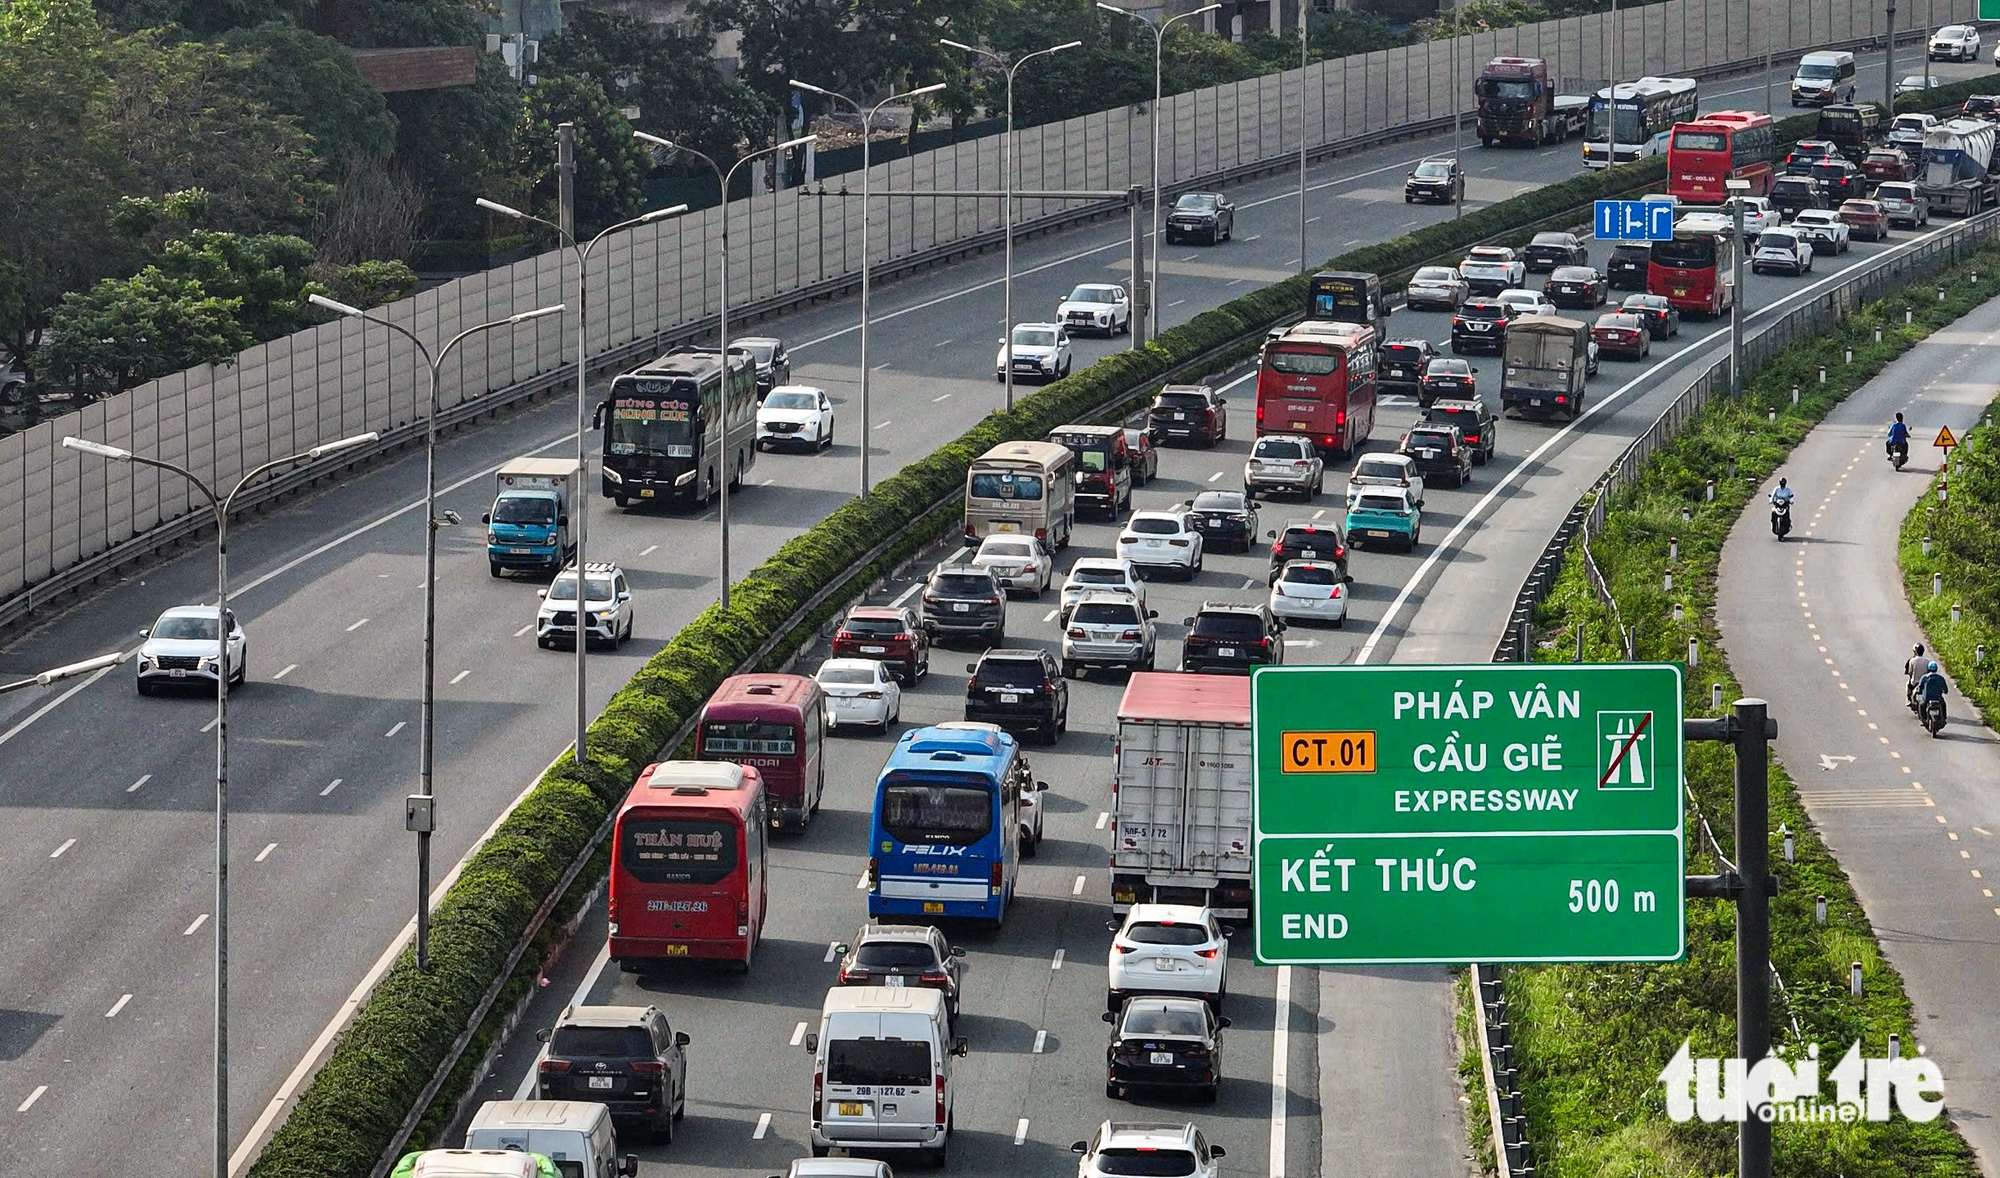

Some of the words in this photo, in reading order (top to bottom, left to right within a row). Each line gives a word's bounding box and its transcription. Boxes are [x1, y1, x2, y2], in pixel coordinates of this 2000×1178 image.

[1393, 680, 1494, 719] PHÁP
[1509, 683, 1580, 719] VÂN
[1292, 738, 1367, 767] CT.01
[1413, 731, 1487, 772] CẦU
[1503, 734, 1562, 771] GIẼ
[1395, 789, 1579, 811] EXPRESSWAY
[901, 844, 967, 856] FELIX
[1281, 844, 1356, 892] KẾT
[1375, 848, 1477, 892] THÚC
[1568, 879, 1620, 914] 500
[1634, 890, 1656, 912] m
[1282, 914, 1348, 939] END
[880, 1087, 906, 1096] 127.62
